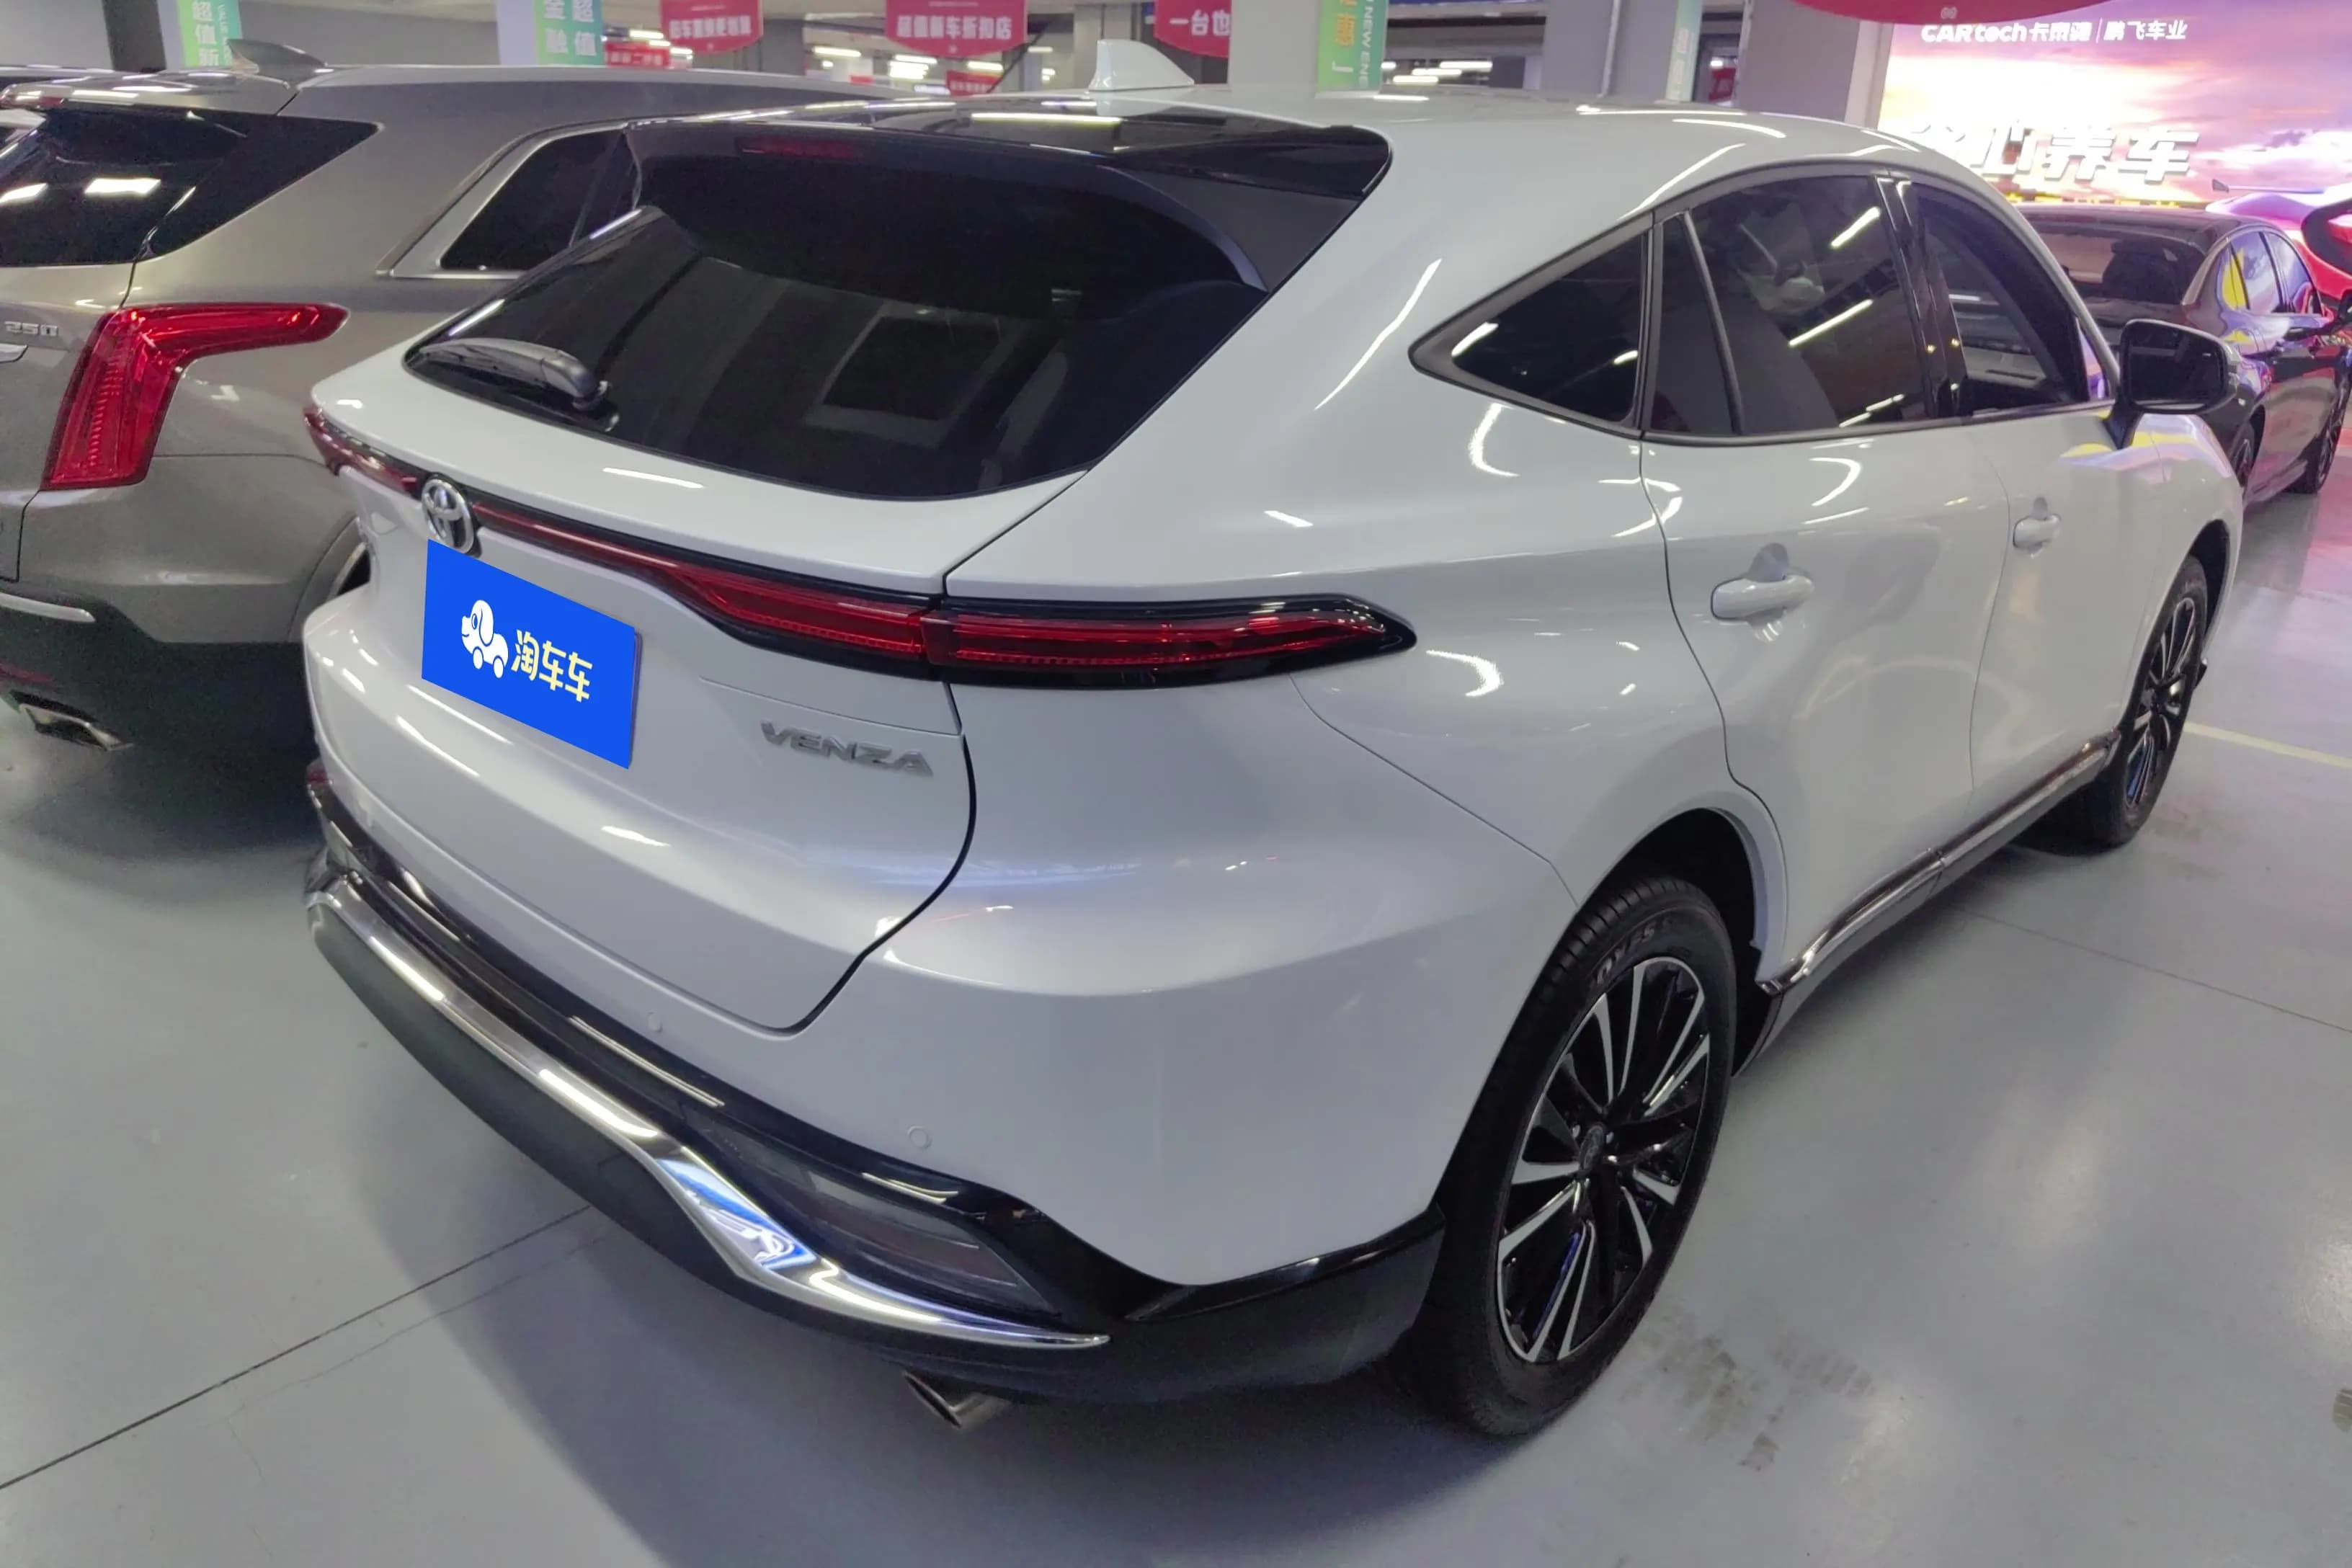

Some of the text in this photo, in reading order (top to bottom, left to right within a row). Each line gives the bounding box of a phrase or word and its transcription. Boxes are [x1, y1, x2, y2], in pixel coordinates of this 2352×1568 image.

[896, 14, 1013, 40] 超值新车折扣店
[2103, 19, 2188, 41] 鹏飞车业
[760, 721, 935, 778] VENZA
